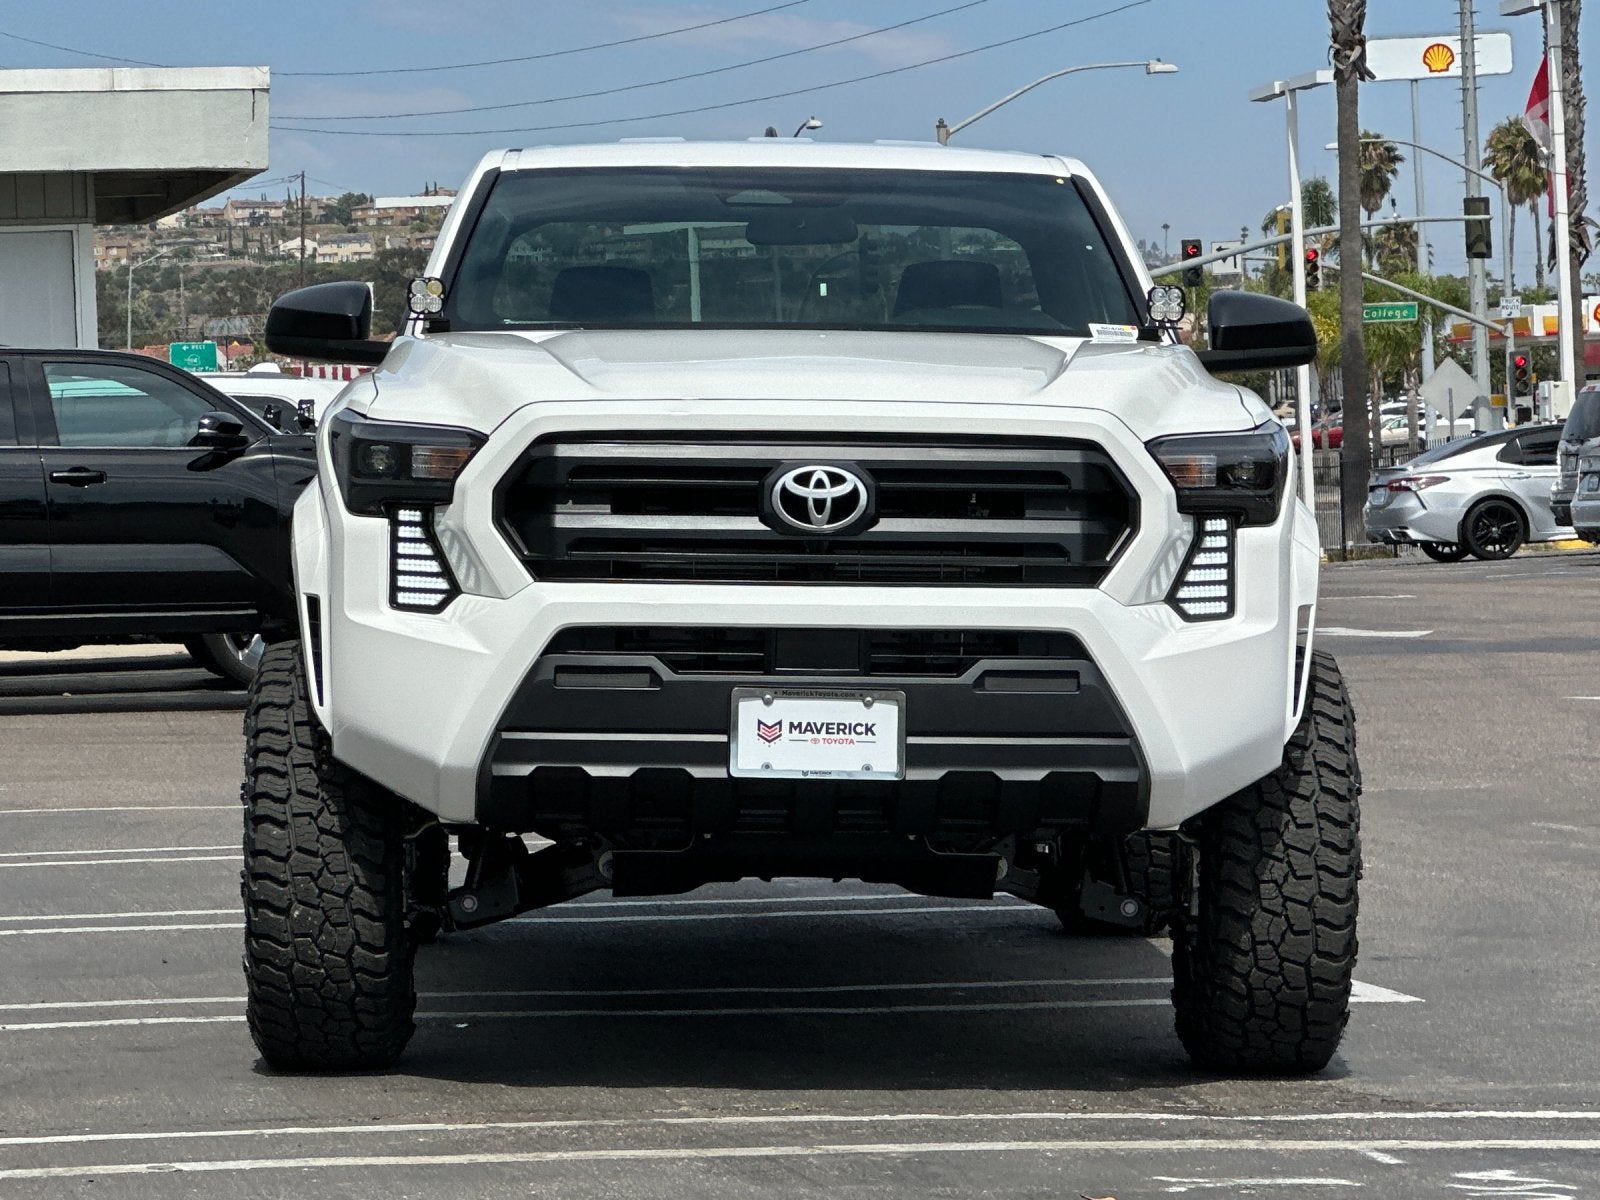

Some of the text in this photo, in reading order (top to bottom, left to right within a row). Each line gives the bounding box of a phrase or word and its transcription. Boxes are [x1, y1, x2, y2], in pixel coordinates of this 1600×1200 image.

[1362, 308, 1409, 319] College
[788, 721, 877, 737] MAVERICK
[821, 737, 855, 745] TOYOTA
